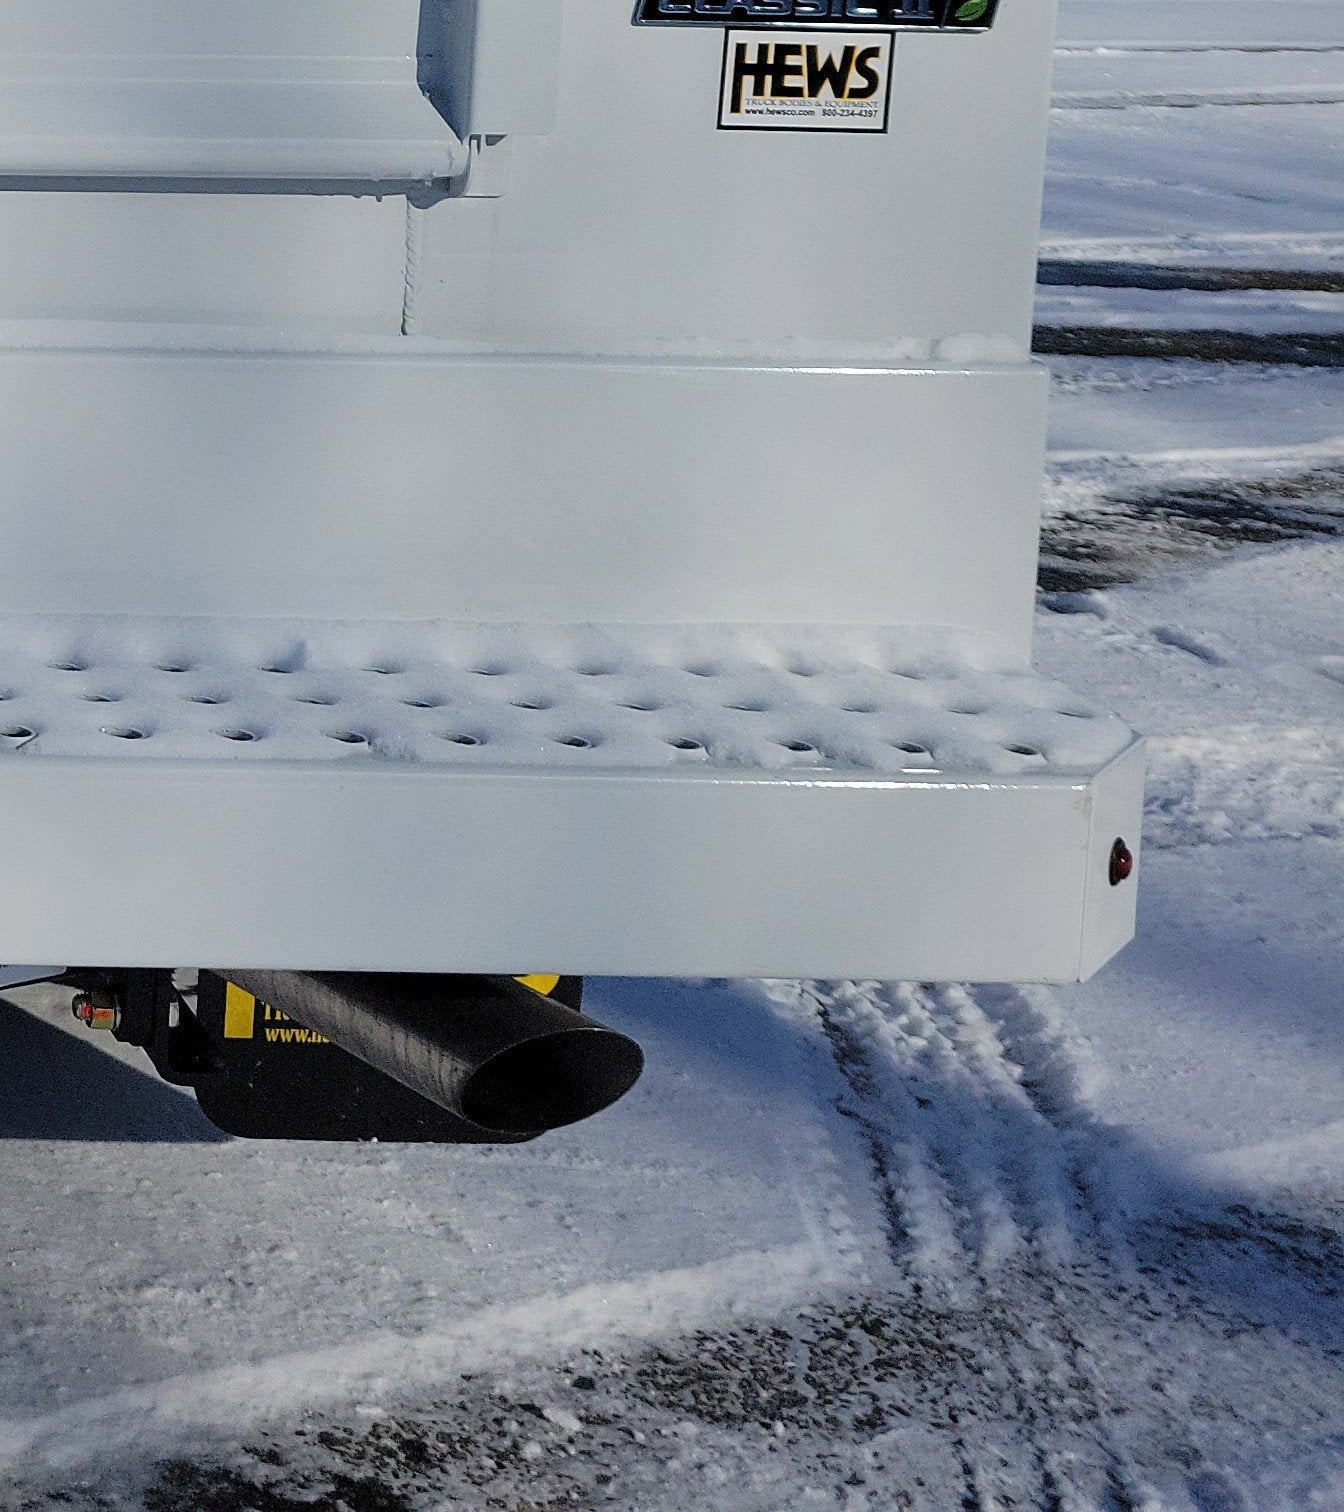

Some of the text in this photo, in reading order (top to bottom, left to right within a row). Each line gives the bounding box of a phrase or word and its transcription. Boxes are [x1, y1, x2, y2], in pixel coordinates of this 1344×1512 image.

[729, 42, 881, 114] HEWS
[744, 97, 777, 107] TRUCK
[779, 98, 812, 108] BODIES
[824, 100, 879, 109] EQUIPMENT
[744, 108, 816, 116] www.hewsco.com
